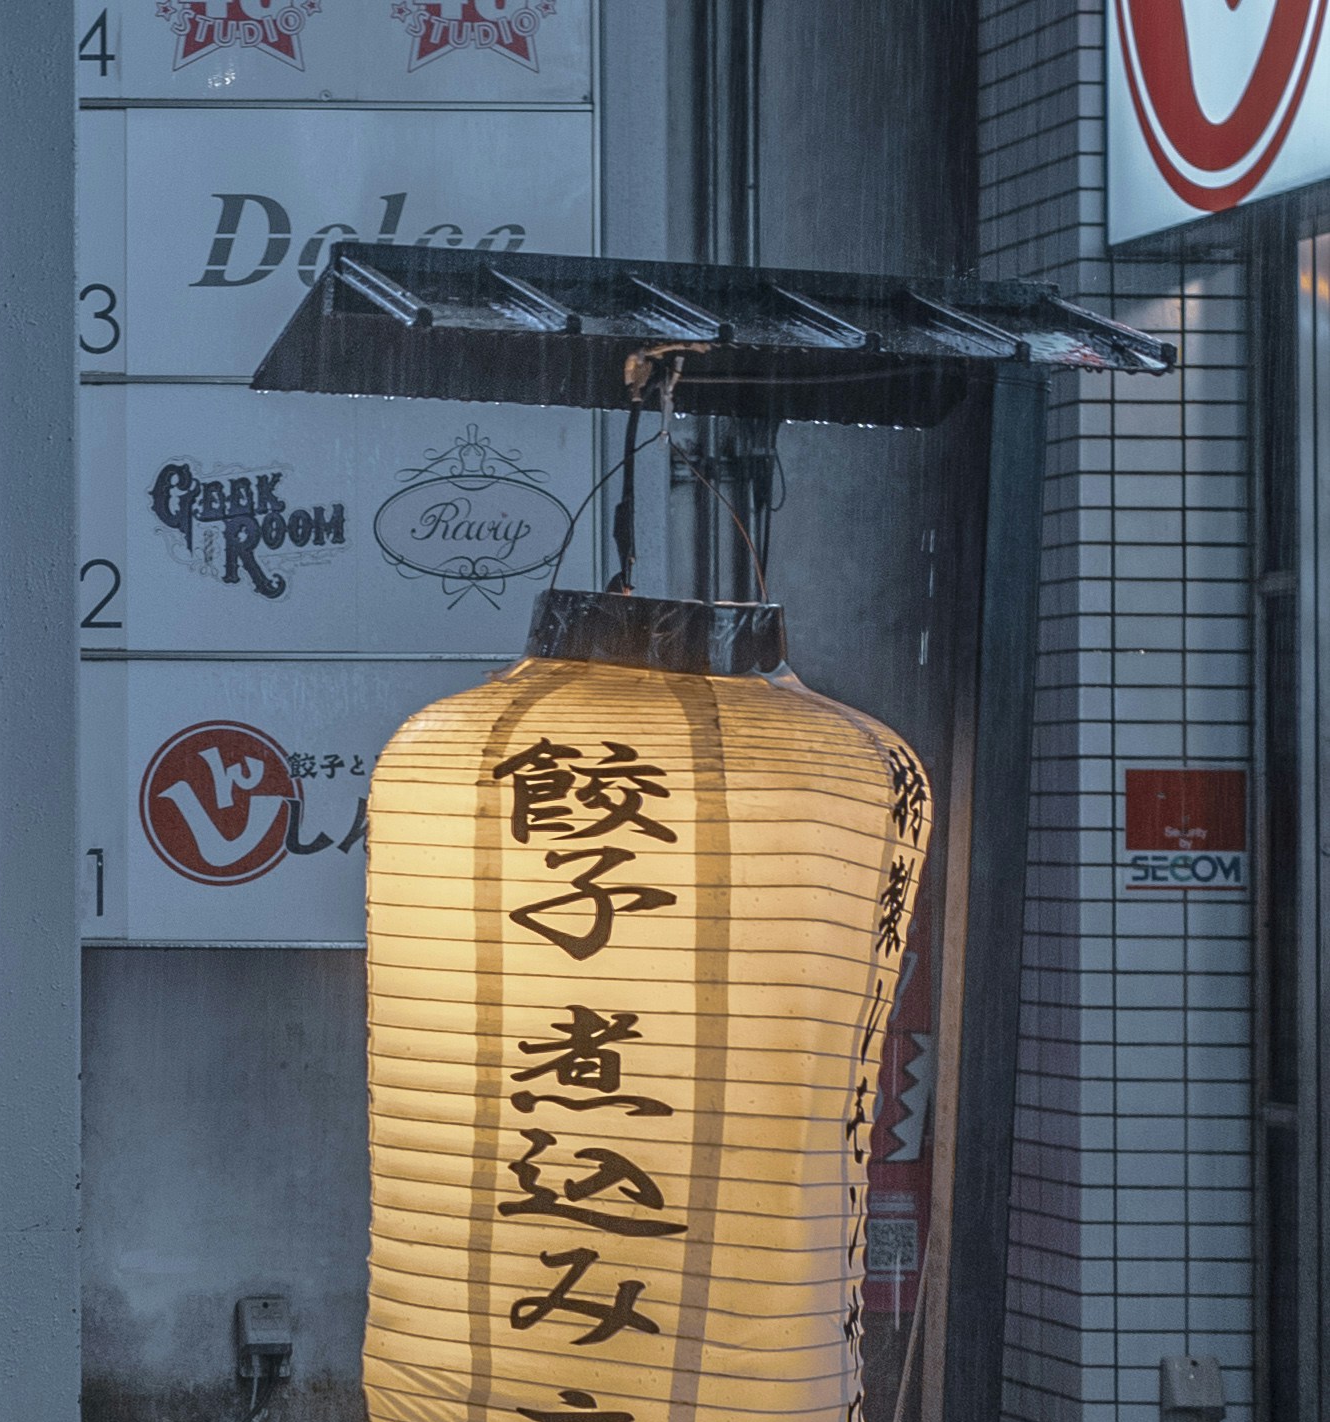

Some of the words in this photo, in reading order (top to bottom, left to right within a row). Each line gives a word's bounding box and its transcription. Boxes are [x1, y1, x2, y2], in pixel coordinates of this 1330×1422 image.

[79, 8, 116, 77] 4
[170, 5, 307, 49] STUDIO
[405, 7, 541, 50] STUDIO
[79, 282, 121, 355] 3
[148, 463, 286, 557] GEEK
[219, 503, 346, 600] ROOM
[80, 557, 123, 629] 2
[288, 752, 380, 779] 餃子と
[85, 848, 104, 917] 1
[492, 736, 678, 963] 餃子
[1131, 854, 1242, 883] SECOM
[497, 1004, 689, 1345] 煮込み
